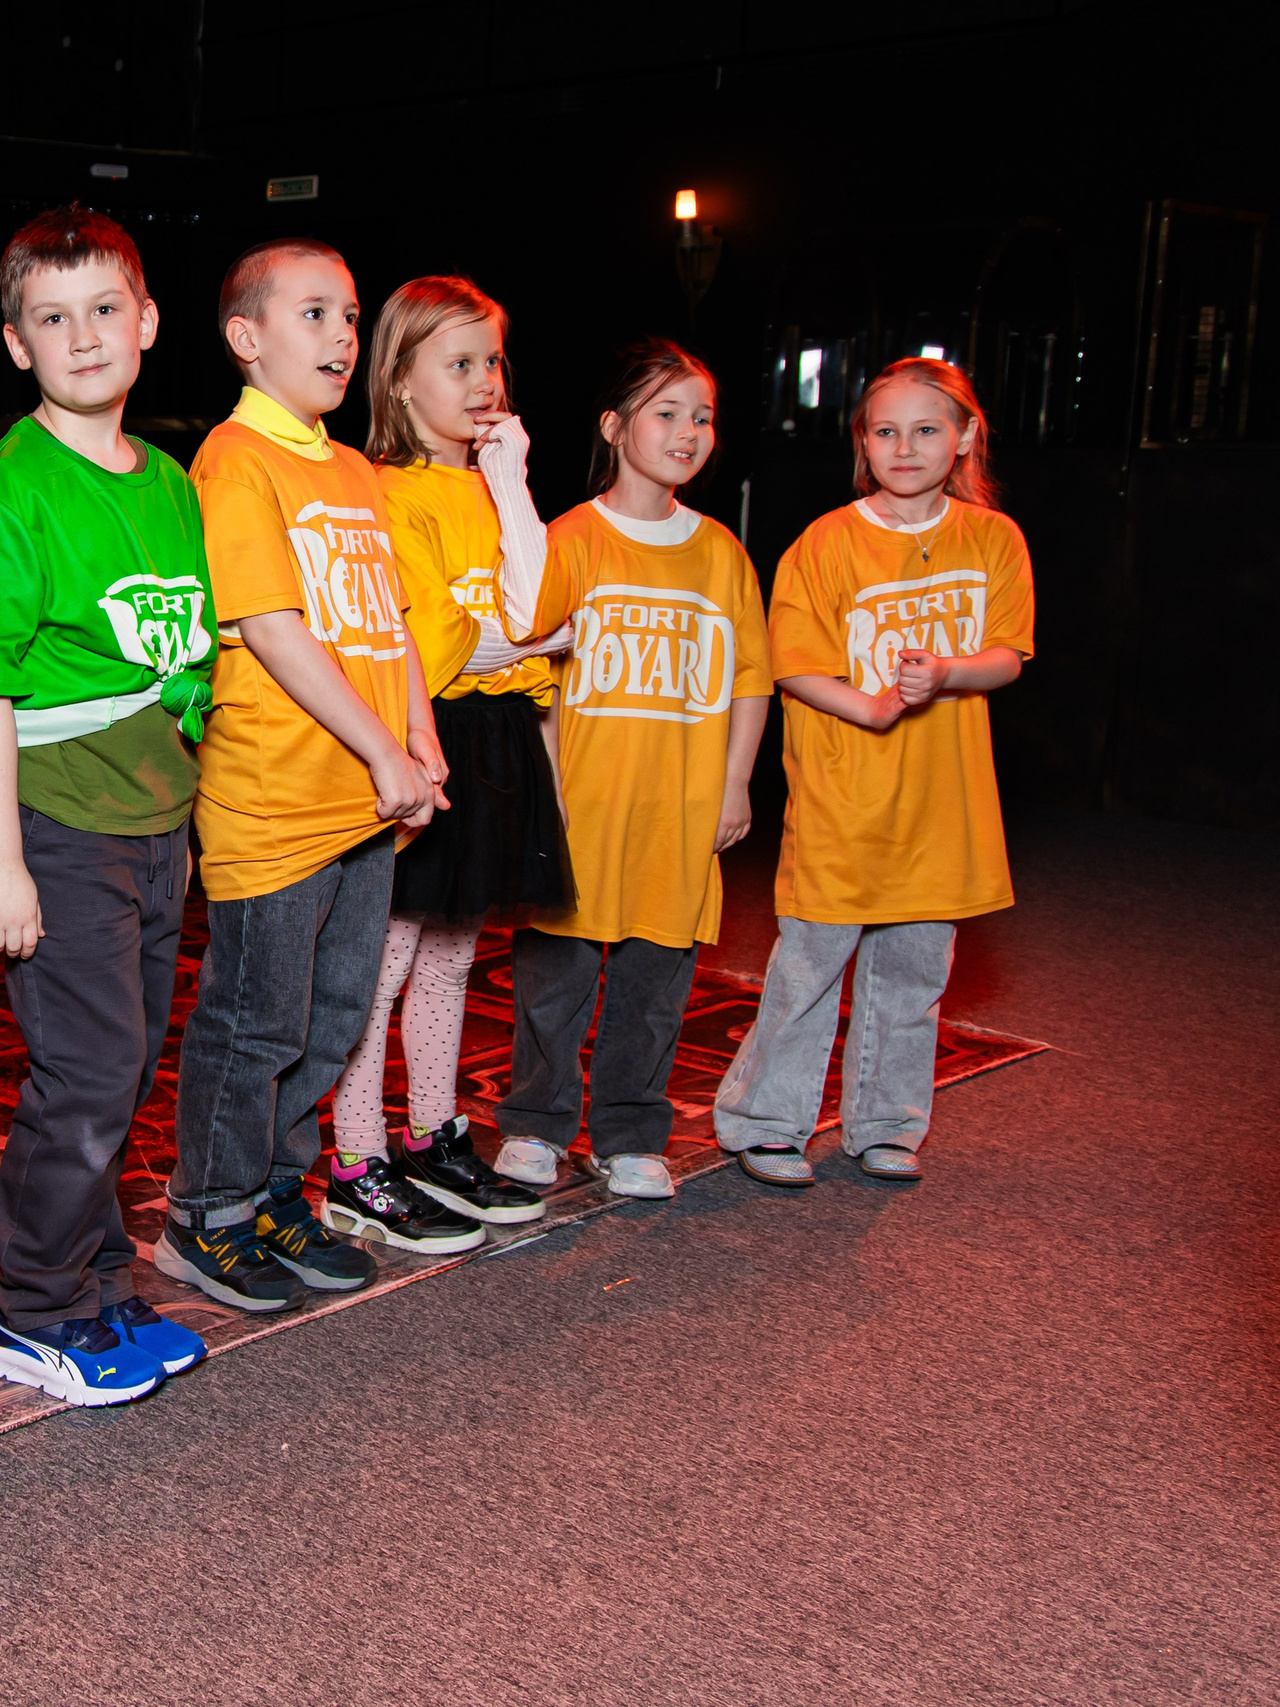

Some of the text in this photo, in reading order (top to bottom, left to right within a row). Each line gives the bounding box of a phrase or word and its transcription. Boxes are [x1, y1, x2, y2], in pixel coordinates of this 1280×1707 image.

[603, 603, 694, 632] FORT
[876, 588, 964, 625] FORT
[565, 606, 736, 714] BOYARD
